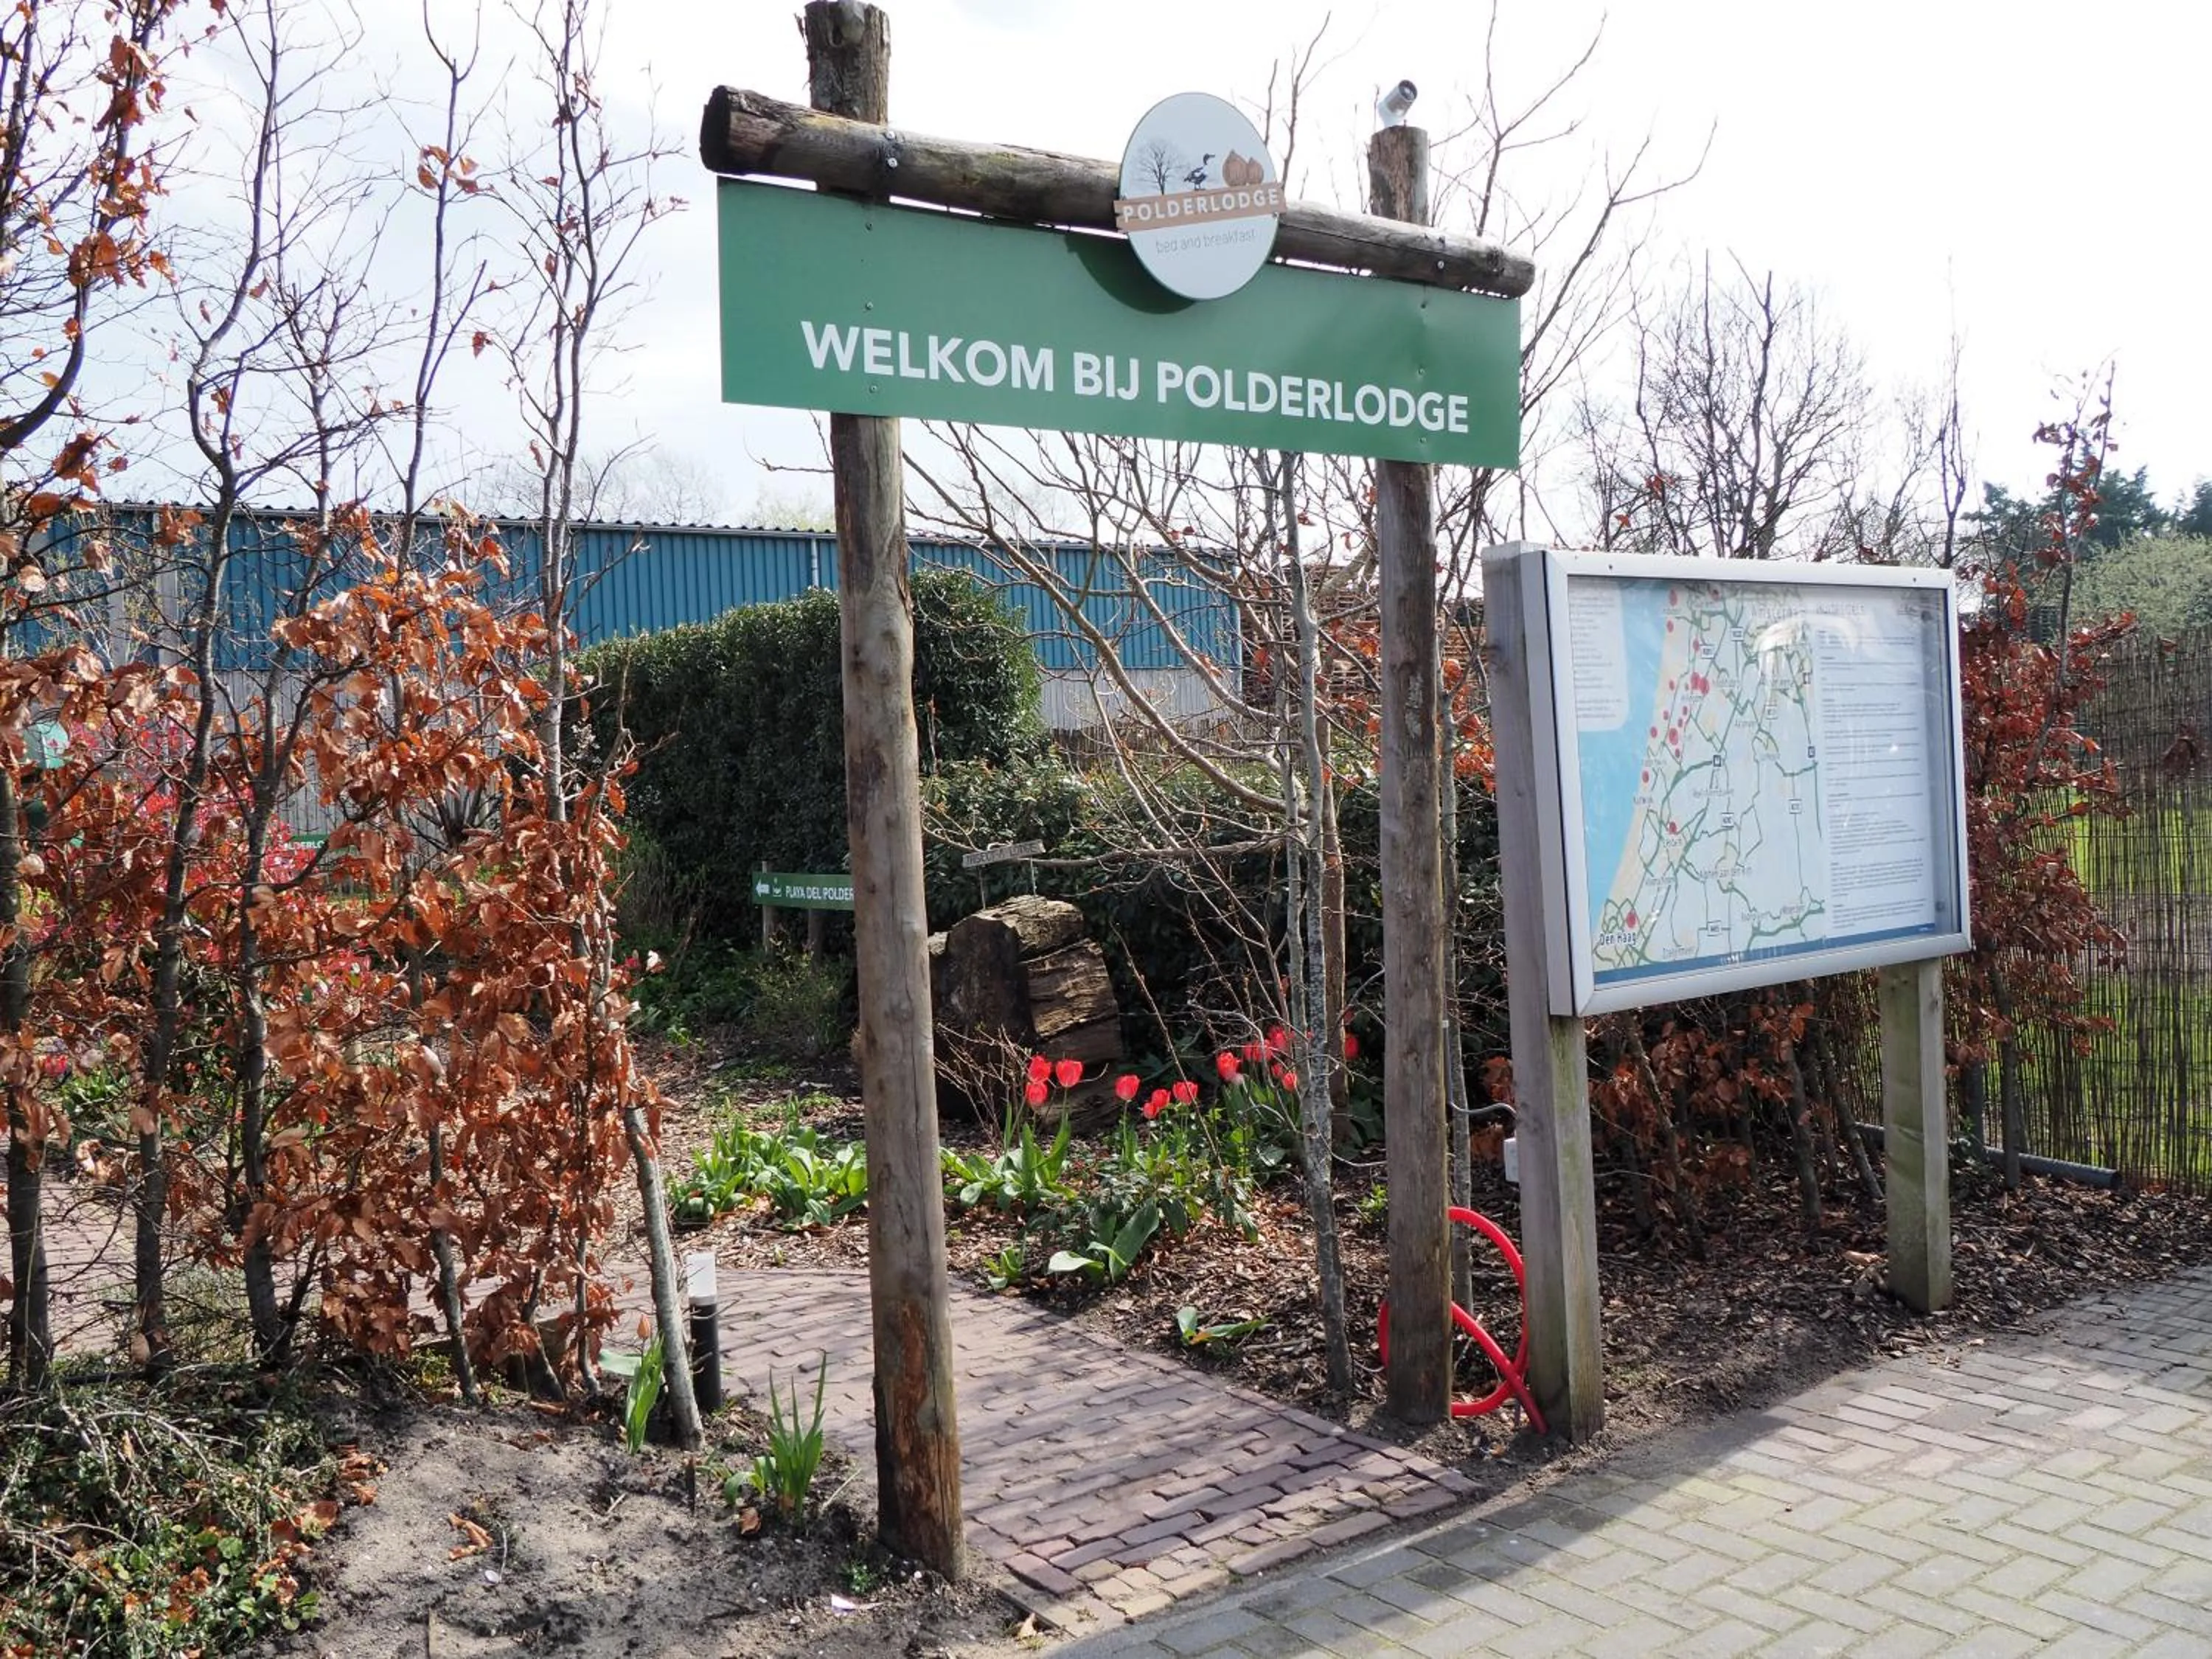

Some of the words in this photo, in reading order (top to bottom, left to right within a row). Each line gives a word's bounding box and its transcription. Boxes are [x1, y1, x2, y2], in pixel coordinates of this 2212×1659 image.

[1123, 188, 1280, 223] POLDERLODGE
[1155, 239, 1178, 254] bed
[1180, 234, 1201, 250] and
[1203, 229, 1256, 247] breakfast
[801, 321, 1054, 392] WELKOM
[1074, 352, 1139, 400] BIJ
[1157, 361, 1469, 433] POLDERLODGE
[786, 886, 805, 899] PLAYA
[807, 886, 821, 900] DEL
[1600, 933, 1615, 945] Den
[1616, 931, 1637, 945] Haag
